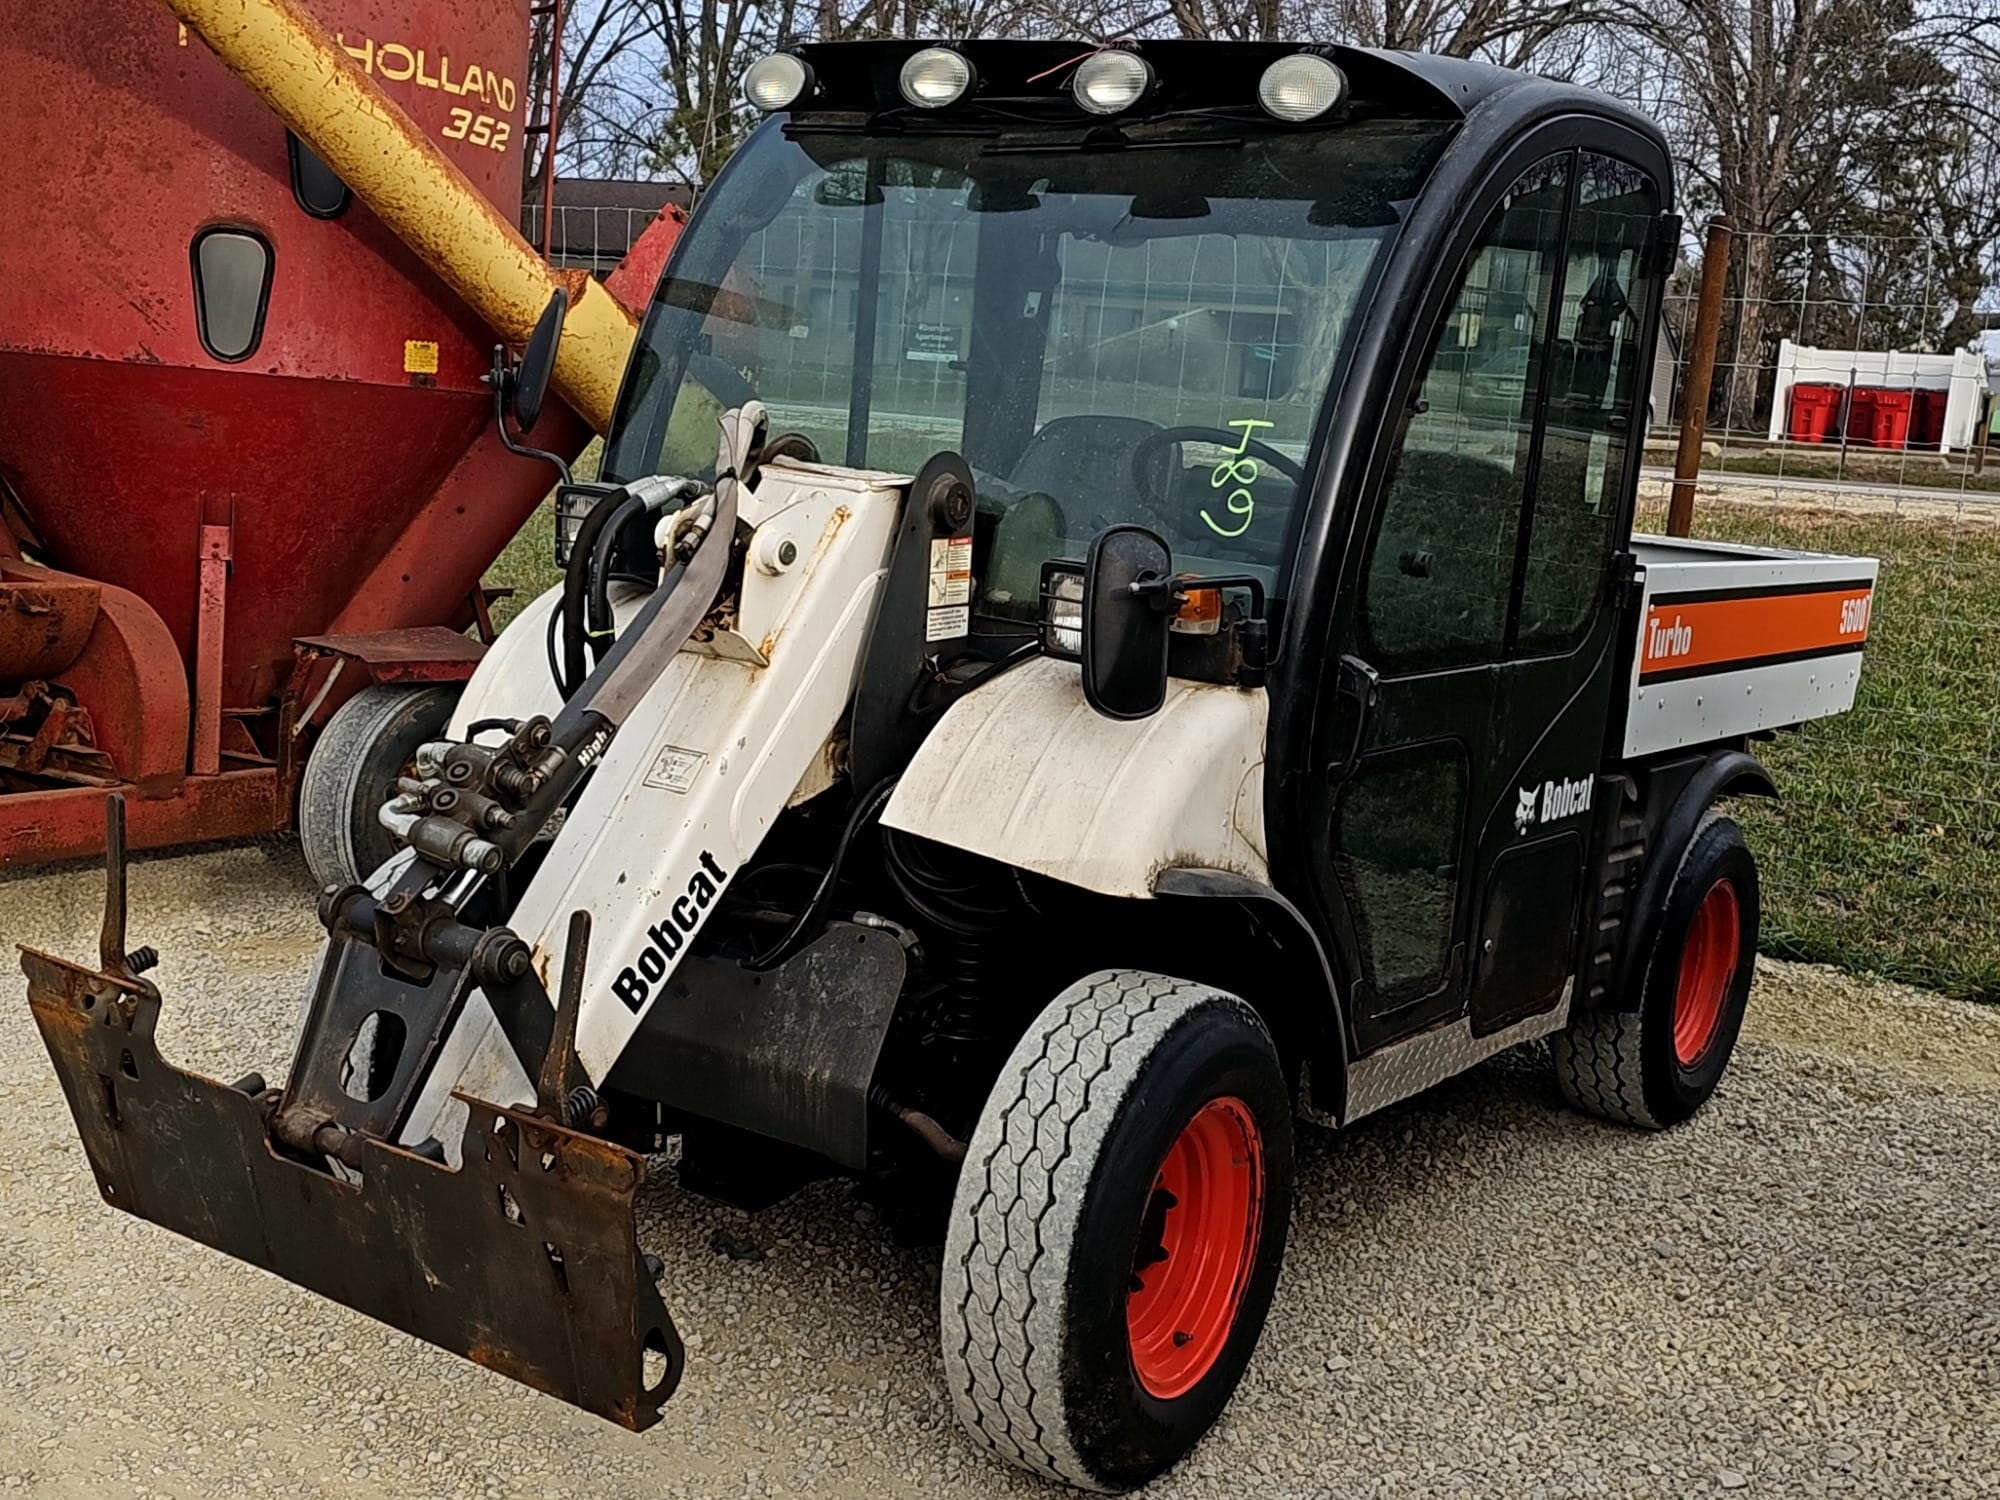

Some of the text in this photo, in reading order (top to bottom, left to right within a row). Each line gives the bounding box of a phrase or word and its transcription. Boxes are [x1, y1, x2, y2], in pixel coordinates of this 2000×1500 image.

[336, 33, 516, 112] HOLLAND
[442, 107, 511, 152] 352
[1648, 598, 1867, 659] Turbo 5600
[577, 731, 607, 767] High
[1540, 772, 1594, 824] Bobcat
[611, 850, 727, 1015] Bobcat
